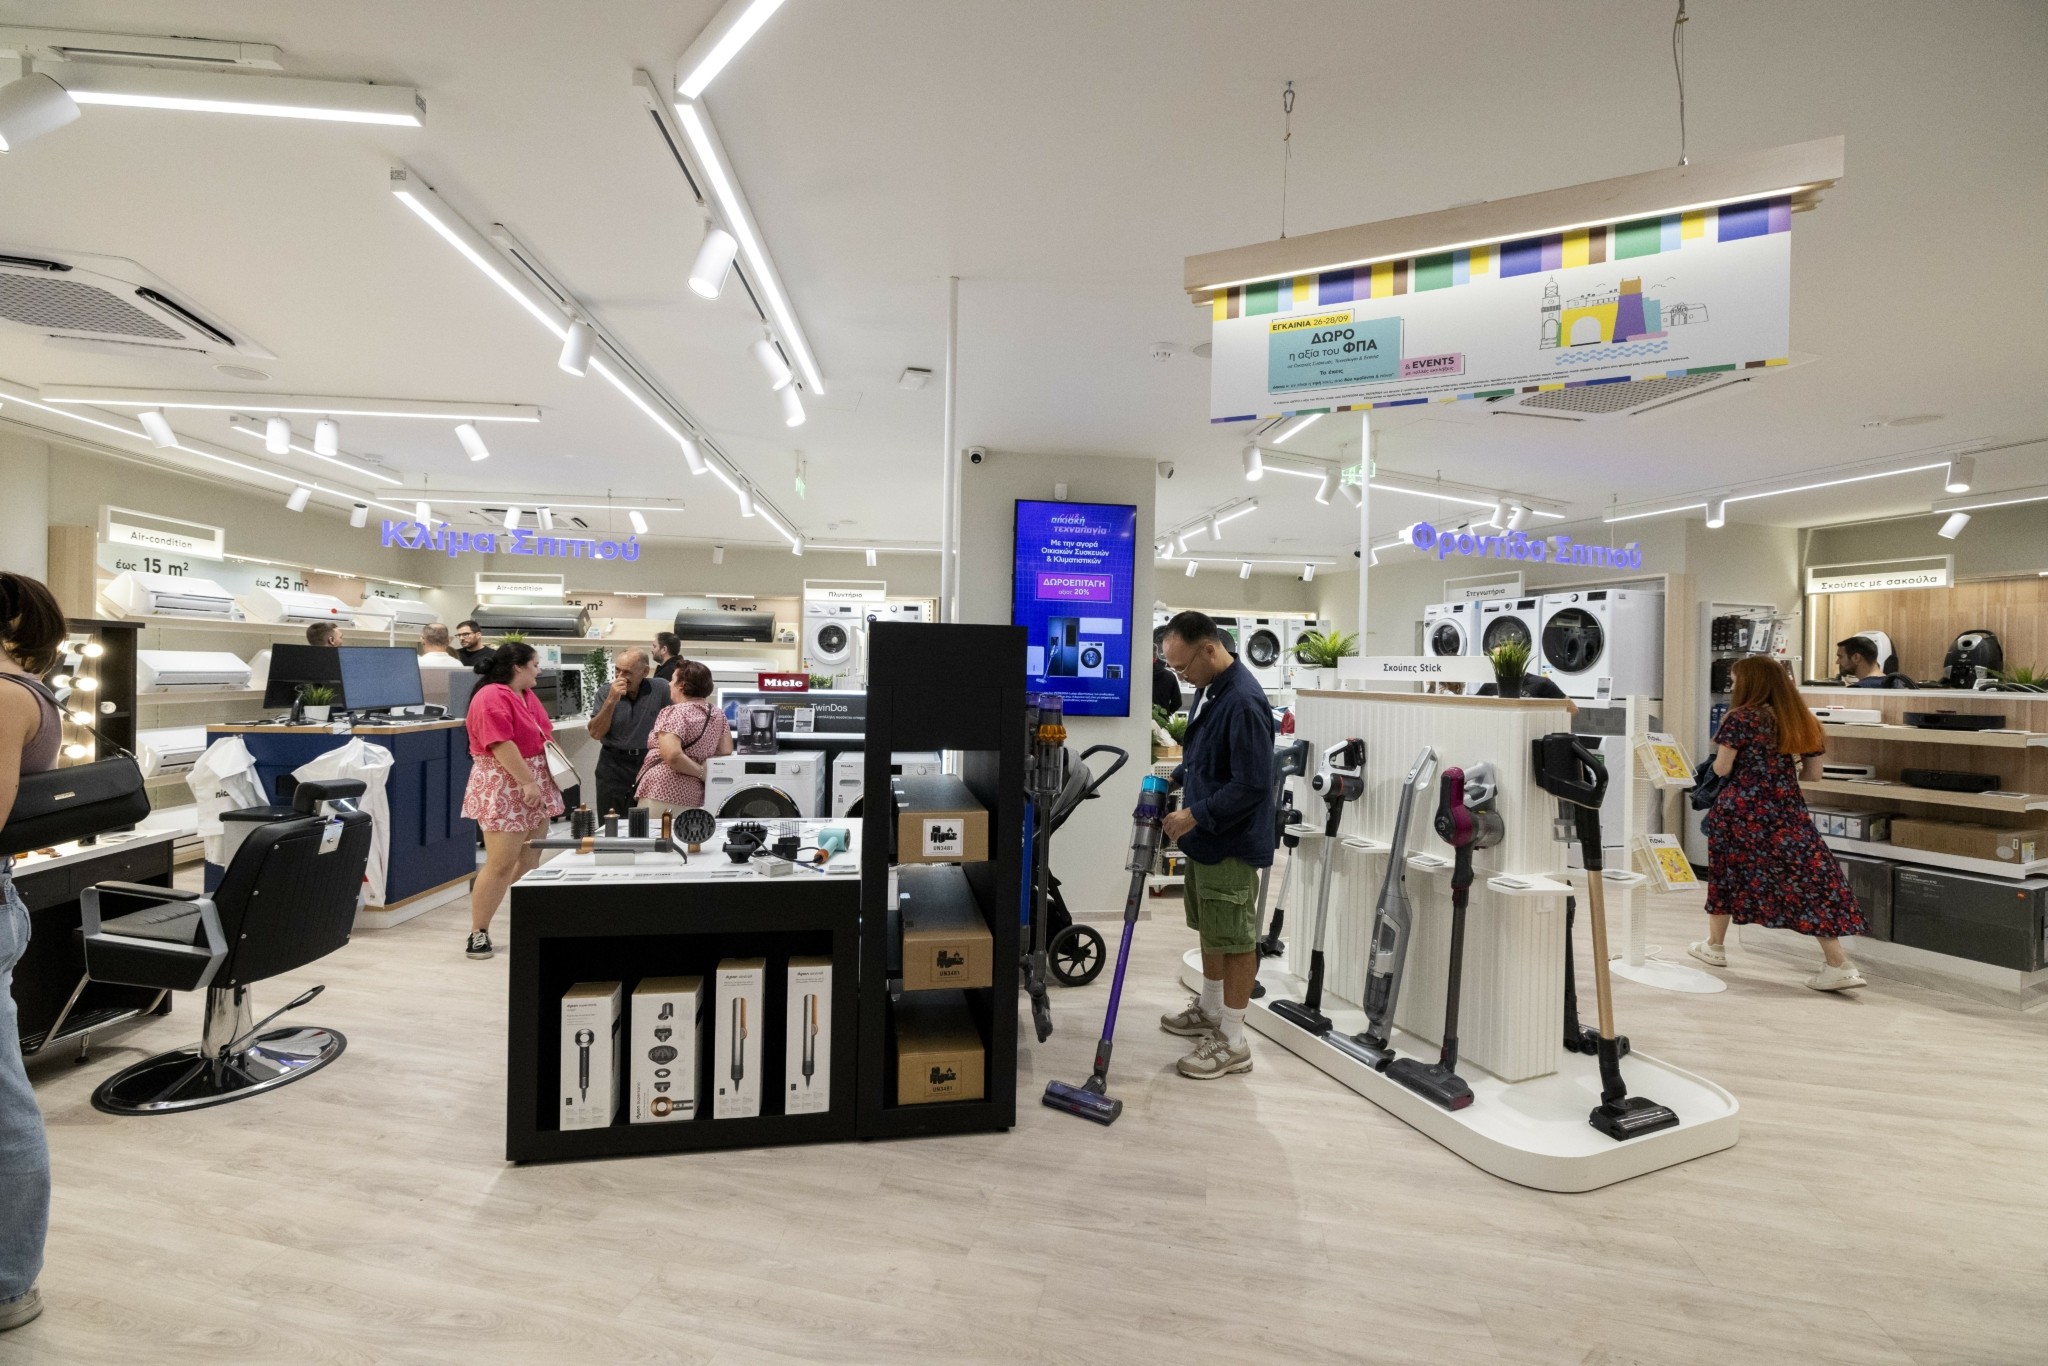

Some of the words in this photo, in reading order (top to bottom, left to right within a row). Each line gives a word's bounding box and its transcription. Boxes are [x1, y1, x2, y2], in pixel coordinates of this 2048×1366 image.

[1272, 320, 1312, 331] ΕΓΚΑΙΝΙΑ
[1313, 315, 1349, 326] 26-28/09
[1311, 328, 1355, 344] ΔΩΡΟ
[1289, 353, 1296, 361] η
[1297, 349, 1319, 361] αξία
[1322, 347, 1340, 357] του
[1342, 339, 1378, 354] ΦΠΑ
[1412, 356, 1455, 369] EVENTS
[130, 530, 194, 549] Air-condition
[381, 520, 496, 558] Κλίμα
[510, 528, 641, 562] Σπιτιού
[1063, 540, 1075, 548] την
[1076, 541, 1099, 549] αγορά
[1411, 521, 1546, 561] Φροντίδα
[1555, 535, 1643, 570] Σπιτιού
[1041, 546, 1073, 555] Οικιακών
[1074, 548, 1110, 557] Συσκευών
[115, 558, 137, 572] έως
[144, 557, 162, 574] 15
[1046, 555, 1052, 563] &
[1053, 555, 1102, 565] Κλιματιστικών
[255, 578, 271, 588] έως
[275, 576, 290, 590] 25
[496, 584, 544, 592] Air-condition
[1043, 578, 1106, 588] ΔΩΡΟΕΠΙΤΑΓΗ
[1821, 579, 1866, 590] Σκούπες
[1869, 578, 1883, 588] με
[1886, 574, 1938, 586] σακούλα
[828, 591, 863, 599] Πλυντήρια
[1074, 588, 1090, 596] 20%
[1465, 588, 1506, 598] Στεγνωτήρια
[1383, 662, 1418, 674] Σκούπες
[1420, 662, 1442, 673] Stick
[763, 678, 804, 688] Miele
[810, 702, 849, 713] TwinDos
